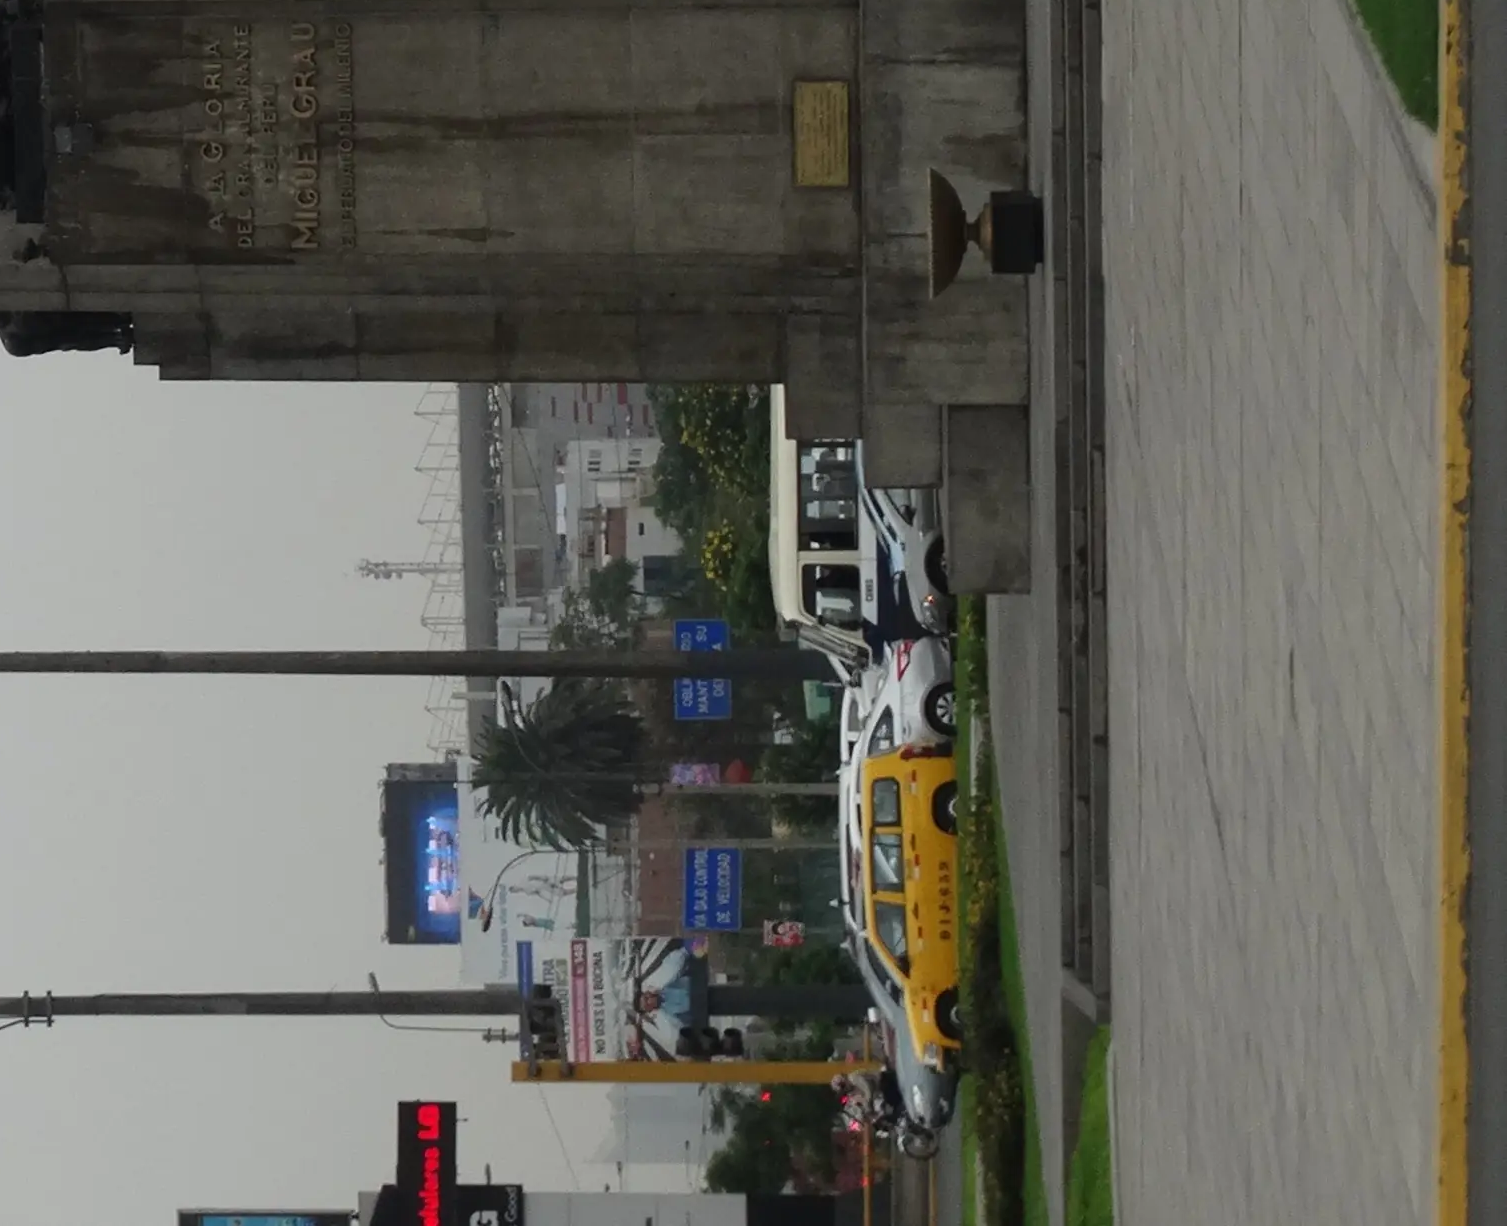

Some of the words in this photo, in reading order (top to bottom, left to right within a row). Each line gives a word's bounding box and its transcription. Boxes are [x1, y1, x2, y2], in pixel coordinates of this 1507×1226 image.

[233, 24, 251, 135] ALMIRANTE
[290, 22, 318, 118] GRAU
[335, 22, 353, 98] MILENIO
[201, 38, 225, 163] GLORIA
[206, 171, 225, 195] LA
[235, 143, 252, 198] GRAN
[262, 148, 278, 186] DEL
[291, 125, 320, 248] MIGUEL
[207, 212, 224, 233] A
[237, 207, 253, 247] DEL
[695, 625, 707, 642] SU
[716, 852, 731, 905] VELOCIDAD
[716, 910, 731, 924] DE
[592, 951, 604, 990] BOCINA
[593, 992, 604, 1007] LA
[594, 1009, 605, 1036] USES
[595, 1038, 605, 1054] NO
